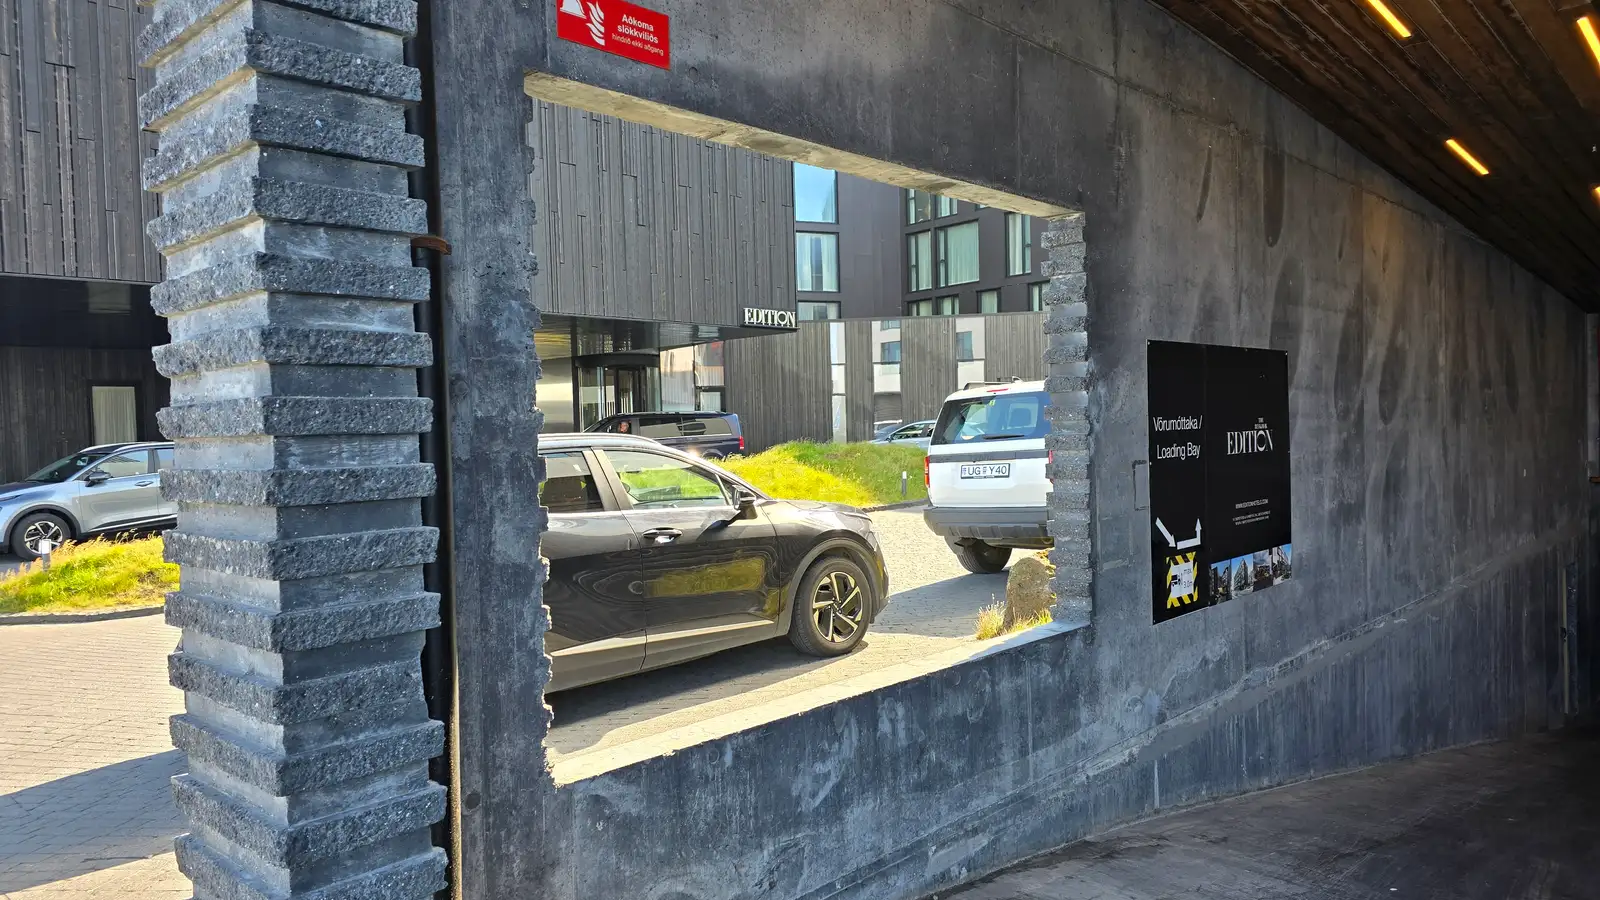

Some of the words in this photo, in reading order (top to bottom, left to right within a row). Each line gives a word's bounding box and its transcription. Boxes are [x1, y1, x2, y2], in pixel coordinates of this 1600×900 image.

[622, 14, 654, 31] Aðkoma
[617, 25, 658, 43] slökkviliðs
[632, 38, 643, 49] ekki
[644, 43, 664, 56] aðgang
[744, 308, 796, 327] EDITION
[1152, 416, 1198, 431] Vörumóttaka
[1156, 443, 1186, 461] Loading
[1186, 441, 1201, 459] Bay
[1226, 429, 1274, 455] EDITION
[967, 466, 980, 475] UG
[989, 465, 1007, 474] Y40
